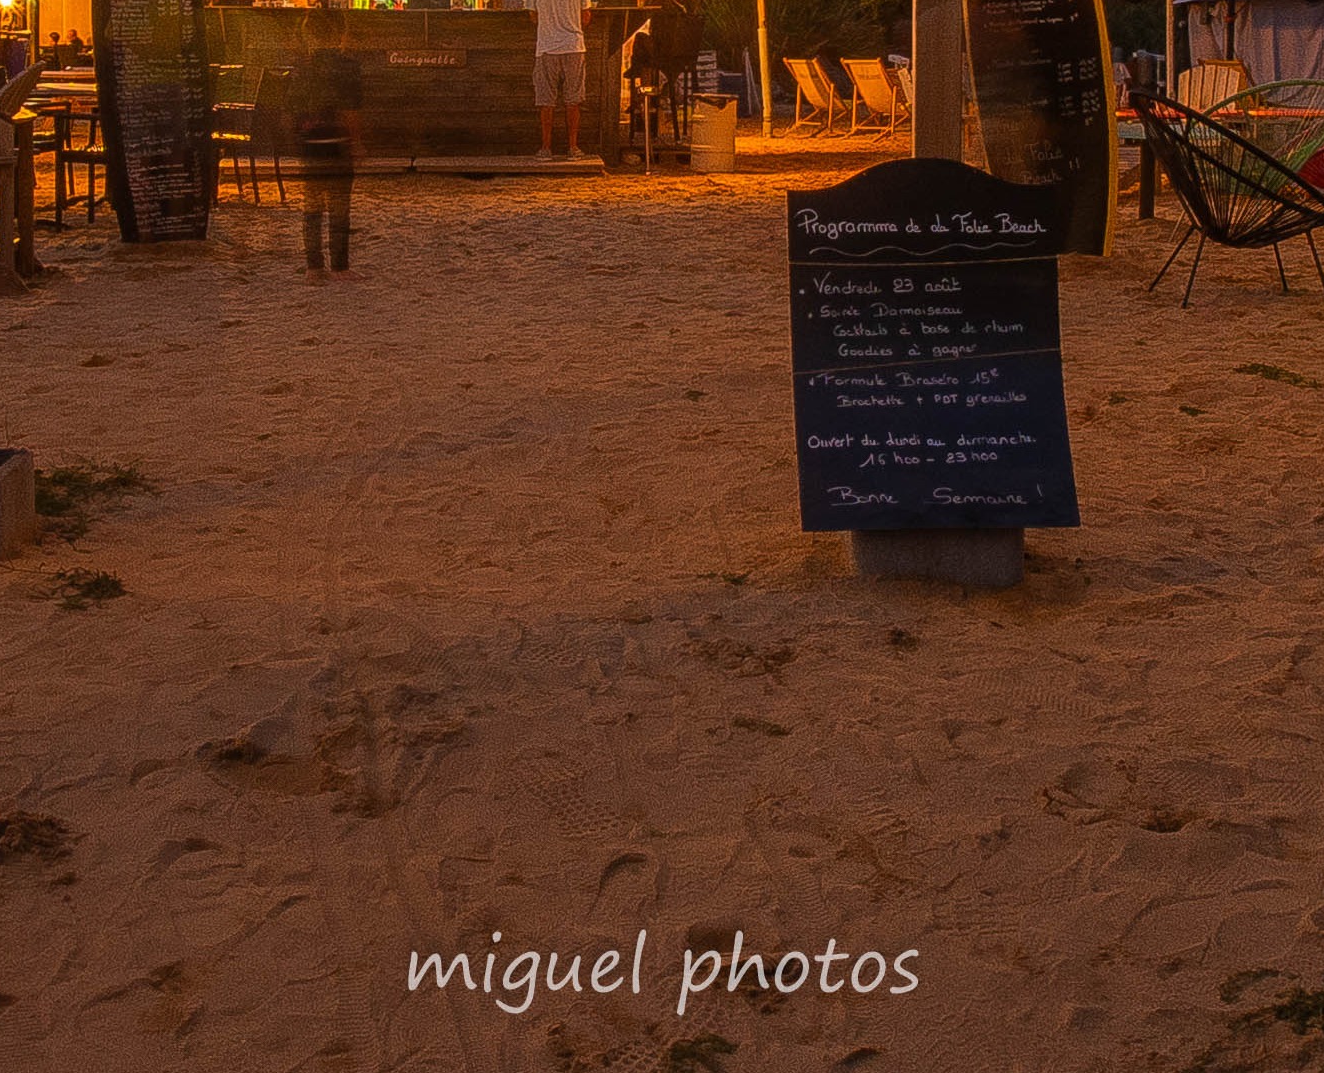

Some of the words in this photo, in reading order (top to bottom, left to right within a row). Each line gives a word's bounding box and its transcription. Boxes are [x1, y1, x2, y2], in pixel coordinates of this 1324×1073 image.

[905, 217, 922, 233] de
[951, 211, 992, 233] Folie
[994, 213, 1048, 233] Beach
[807, 433, 854, 449] Ouvert
[927, 486, 1029, 505] Semaine
